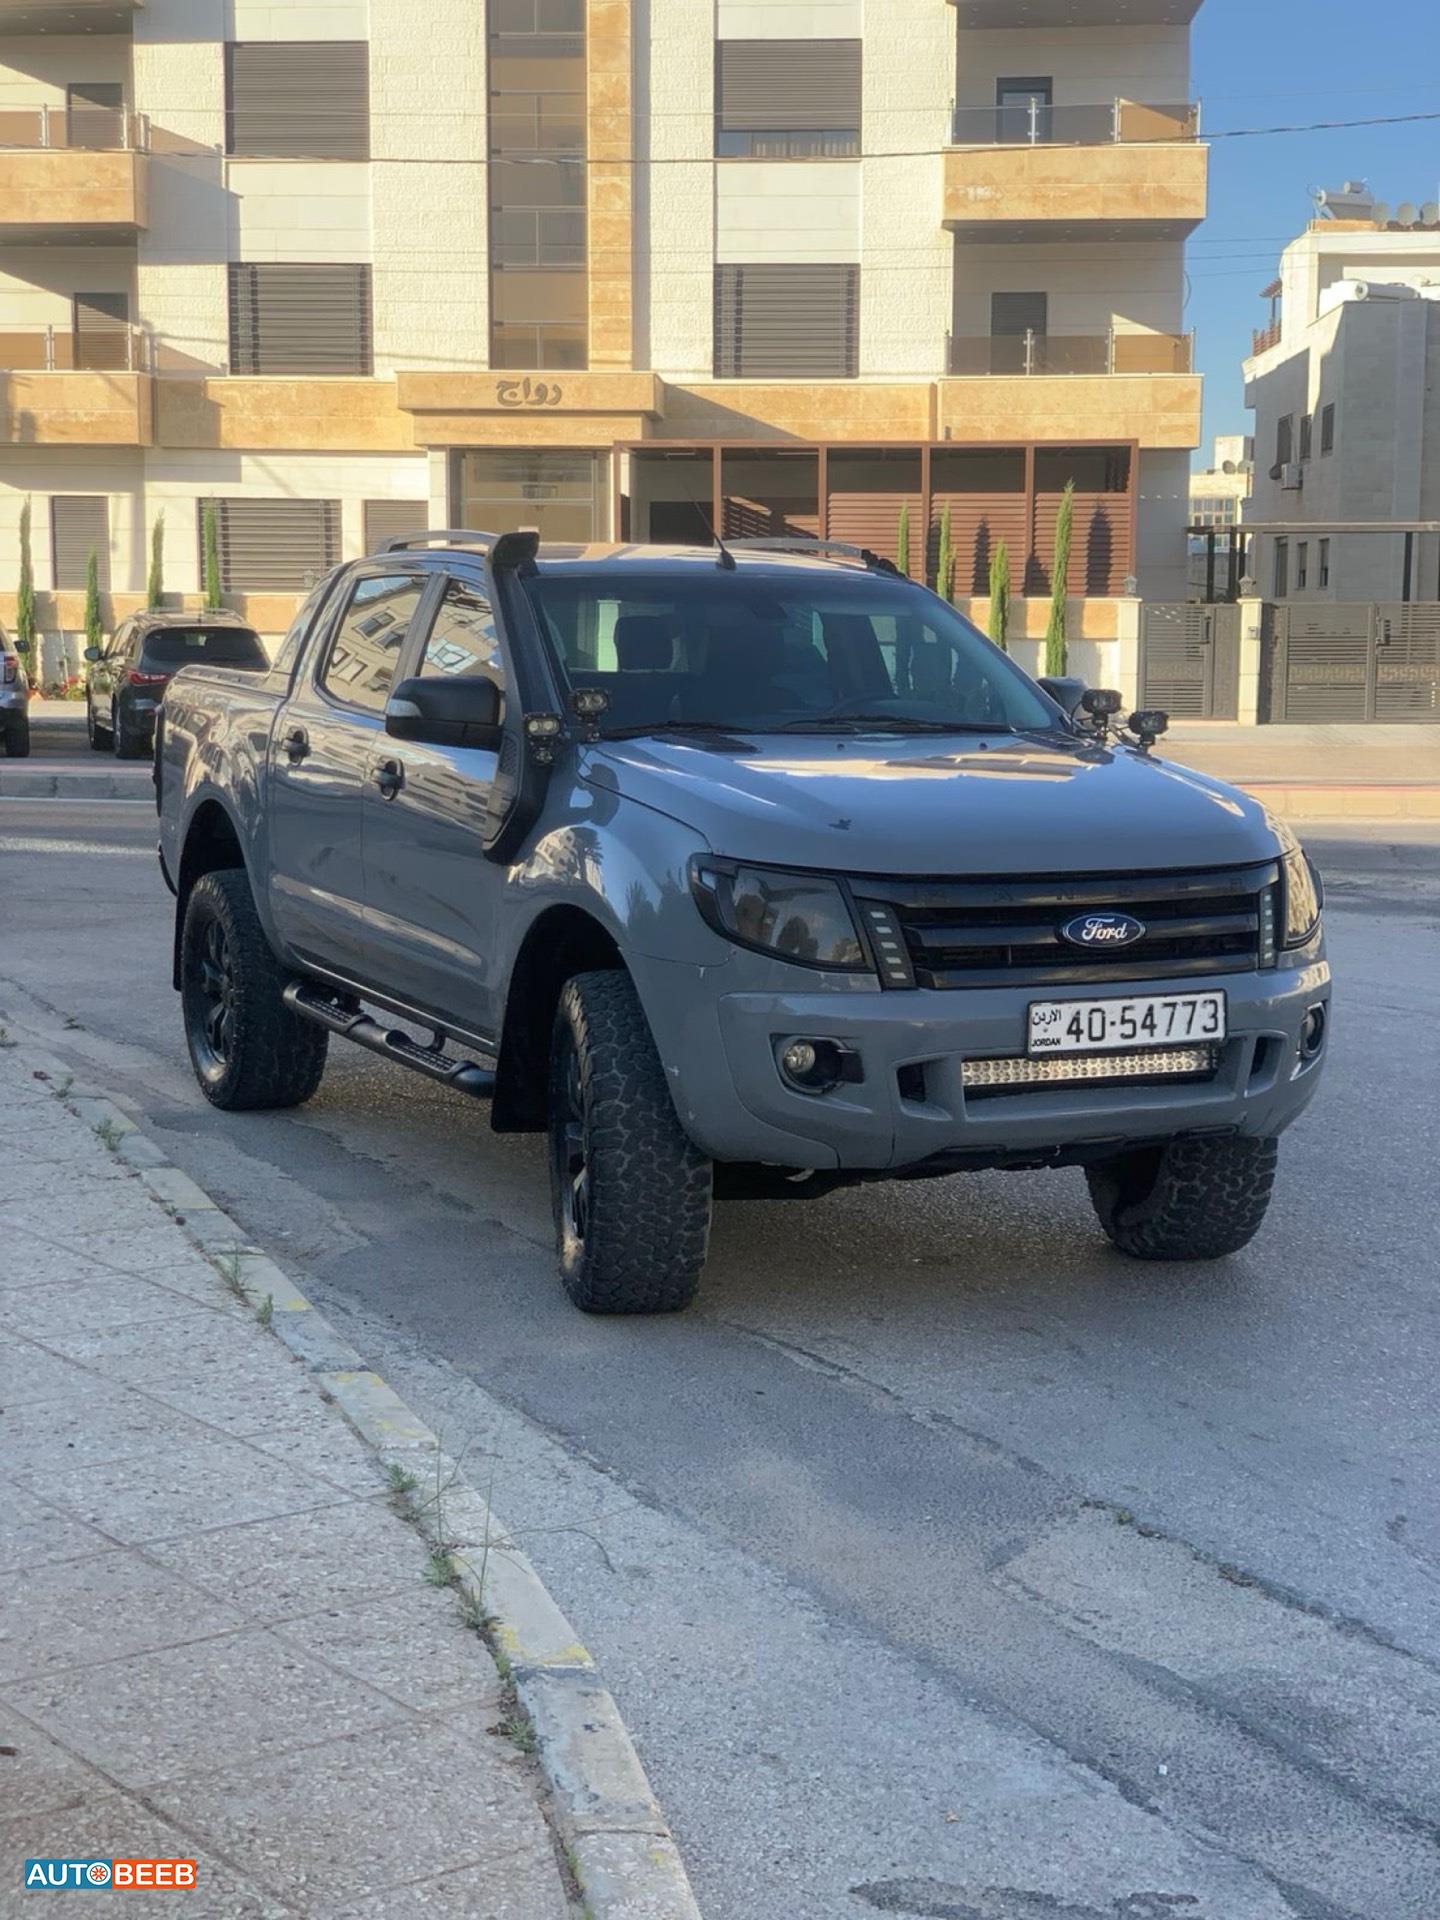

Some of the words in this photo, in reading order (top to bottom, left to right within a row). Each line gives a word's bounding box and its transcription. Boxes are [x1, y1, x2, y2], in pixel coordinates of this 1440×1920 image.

[496, 377, 562, 407] رواج
[1081, 917, 1129, 941] Ford
[1066, 998, 1219, 1043] 40-54773
[1031, 1037, 1061, 1048] JORDAN
